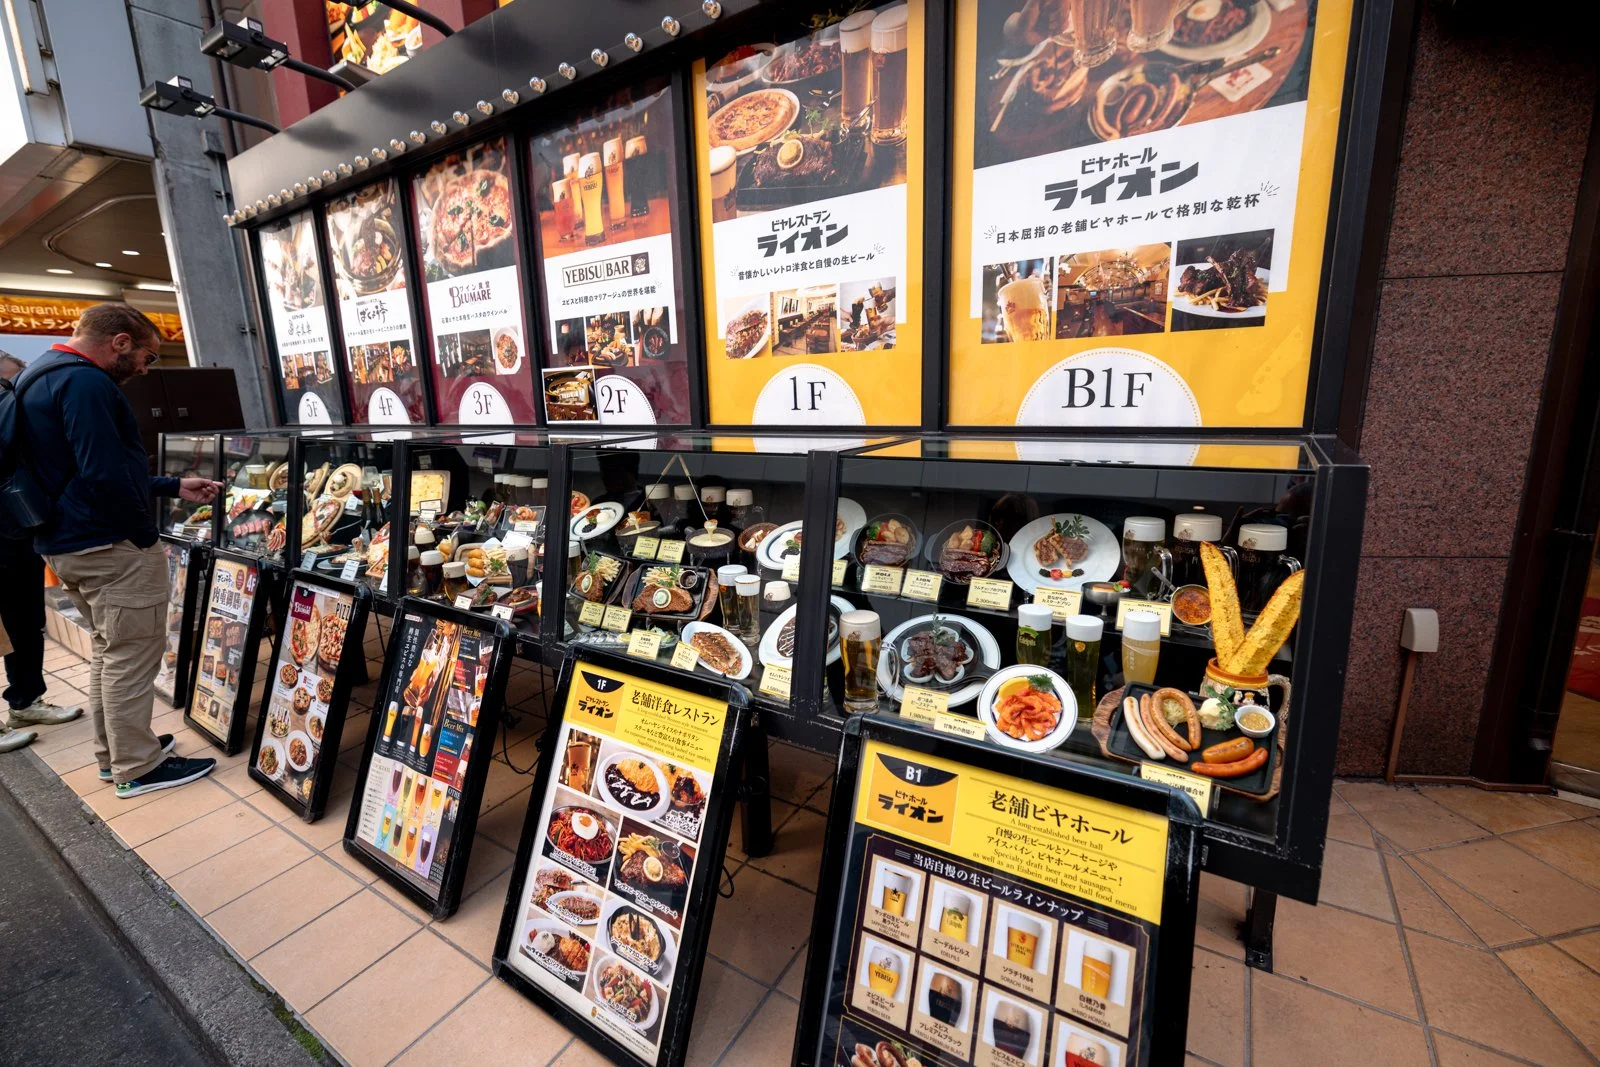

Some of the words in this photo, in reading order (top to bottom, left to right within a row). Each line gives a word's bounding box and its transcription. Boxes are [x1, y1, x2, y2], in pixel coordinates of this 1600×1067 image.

[1081, 147, 1158, 174] ビヤホール
[1044, 162, 1200, 211] ライオン
[772, 210, 830, 232] ビヤレストラン
[996, 193, 1261, 244] 日本屈指の老舗ビヤホールで格別な乾杯
[757, 224, 848, 258] ライオン
[566, 265, 602, 284] YEBISU
[606, 260, 630, 276] BAR
[738, 252, 875, 280] 昔懐かしいレトロ洋食と自慢の生ビール
[600, 384, 628, 414] 2F
[790, 376, 826, 410] 1F
[1062, 367, 1152, 408] B1F
[306, 399, 318, 418] 5F
[378, 396, 392, 416] 4F
[473, 390, 492, 416] 3F
[246, 574, 256, 592] 4F
[597, 679, 606, 690] 1F
[578, 700, 614, 718] ライオン
[585, 696, 610, 706] ビヤレストラン
[631, 690, 720, 726] 老舗洋食レストラン
[444, 719, 456, 730] Beer
[905, 765, 922, 784] B1
[878, 793, 944, 824] ライオン
[895, 790, 928, 806] ビヤホール
[988, 790, 1134, 846] 老舗ビヤホール
[1018, 820, 1070, 841] long-established
[1071, 835, 1087, 846] beer
[1089, 840, 1103, 850] hall
[996, 828, 1118, 871] 自慢の生ビールとソーセージや
[981, 853, 995, 863] well
[1005, 862, 1014, 870] an
[1044, 874, 1057, 884] and
[1060, 879, 1076, 891] beer
[1078, 885, 1093, 896] hall
[1094, 890, 1112, 903] food
[1115, 898, 1137, 911] menu
[993, 848, 1023, 864] Specialty
[1025, 858, 1043, 870] draft
[1045, 864, 1061, 876] beer
[1063, 870, 1078, 881] and
[1079, 877, 1114, 894] sausages,
[912, 853, 1084, 921] 当店自慢の生ビールラインナップ
[875, 970, 894, 984] YEBISU
[1002, 966, 1033, 983] ソラチ1984
[920, 1022, 962, 1047] プレミアムブラック
